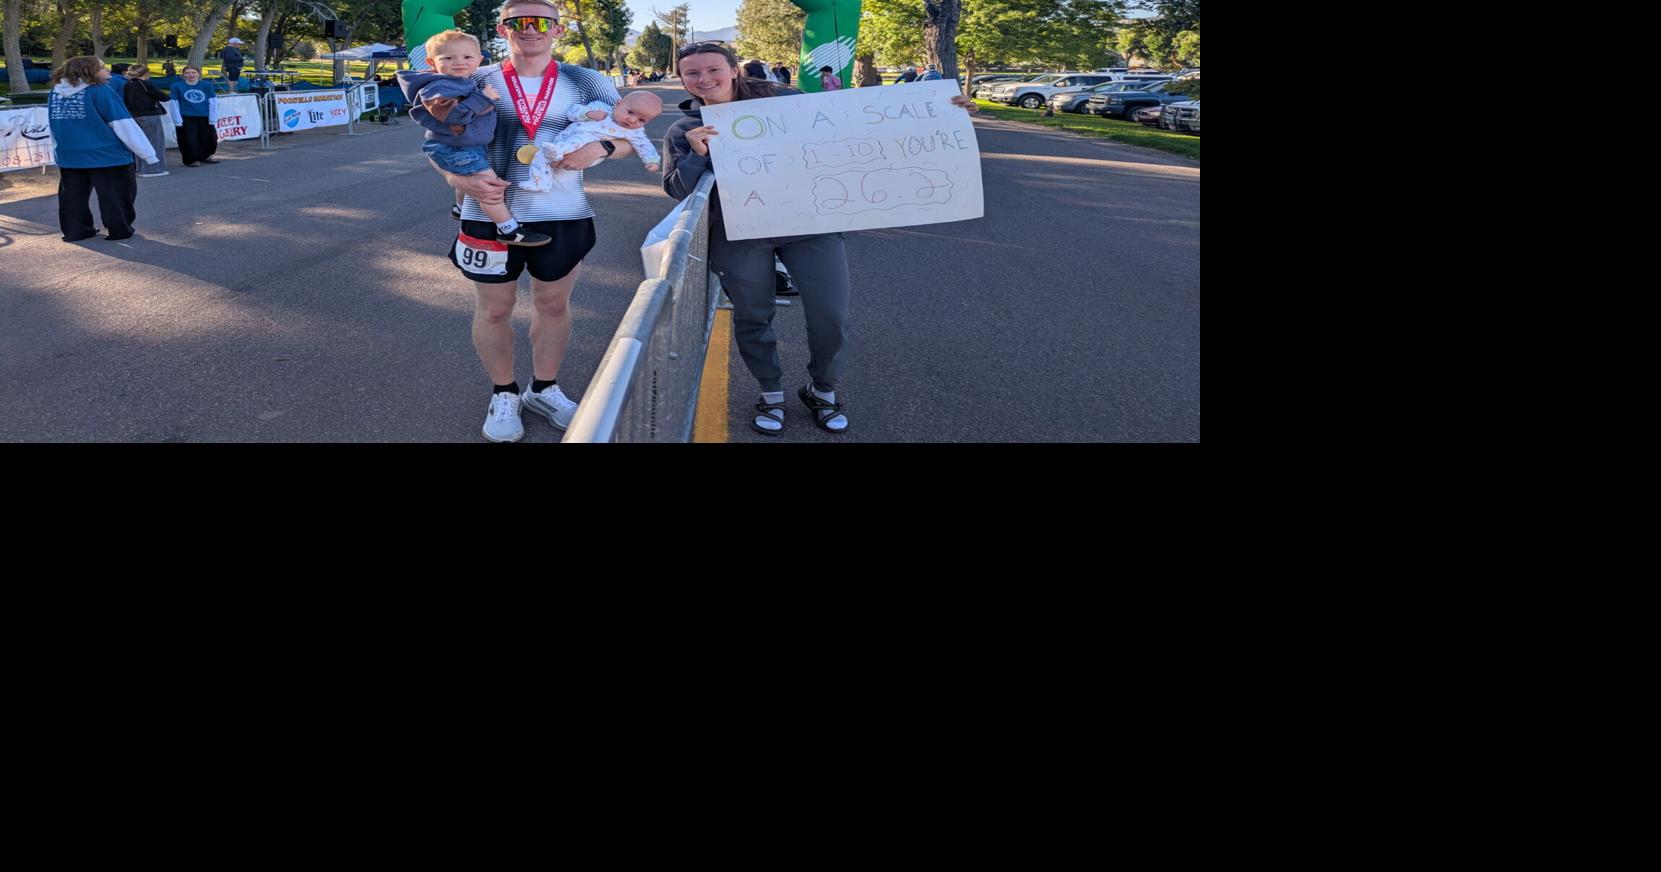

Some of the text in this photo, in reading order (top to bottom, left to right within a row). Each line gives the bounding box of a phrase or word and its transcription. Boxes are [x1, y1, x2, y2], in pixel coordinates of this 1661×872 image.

[544, 77, 555, 100] MARATHON
[307, 109, 325, 123] Lite
[731, 101, 938, 140] ON A SCALE
[217, 126, 248, 139] GERY
[737, 153, 777, 175] OF
[895, 130, 969, 158] YOU'RE
[744, 172, 949, 210] A 26.2
[462, 247, 488, 268] 99
